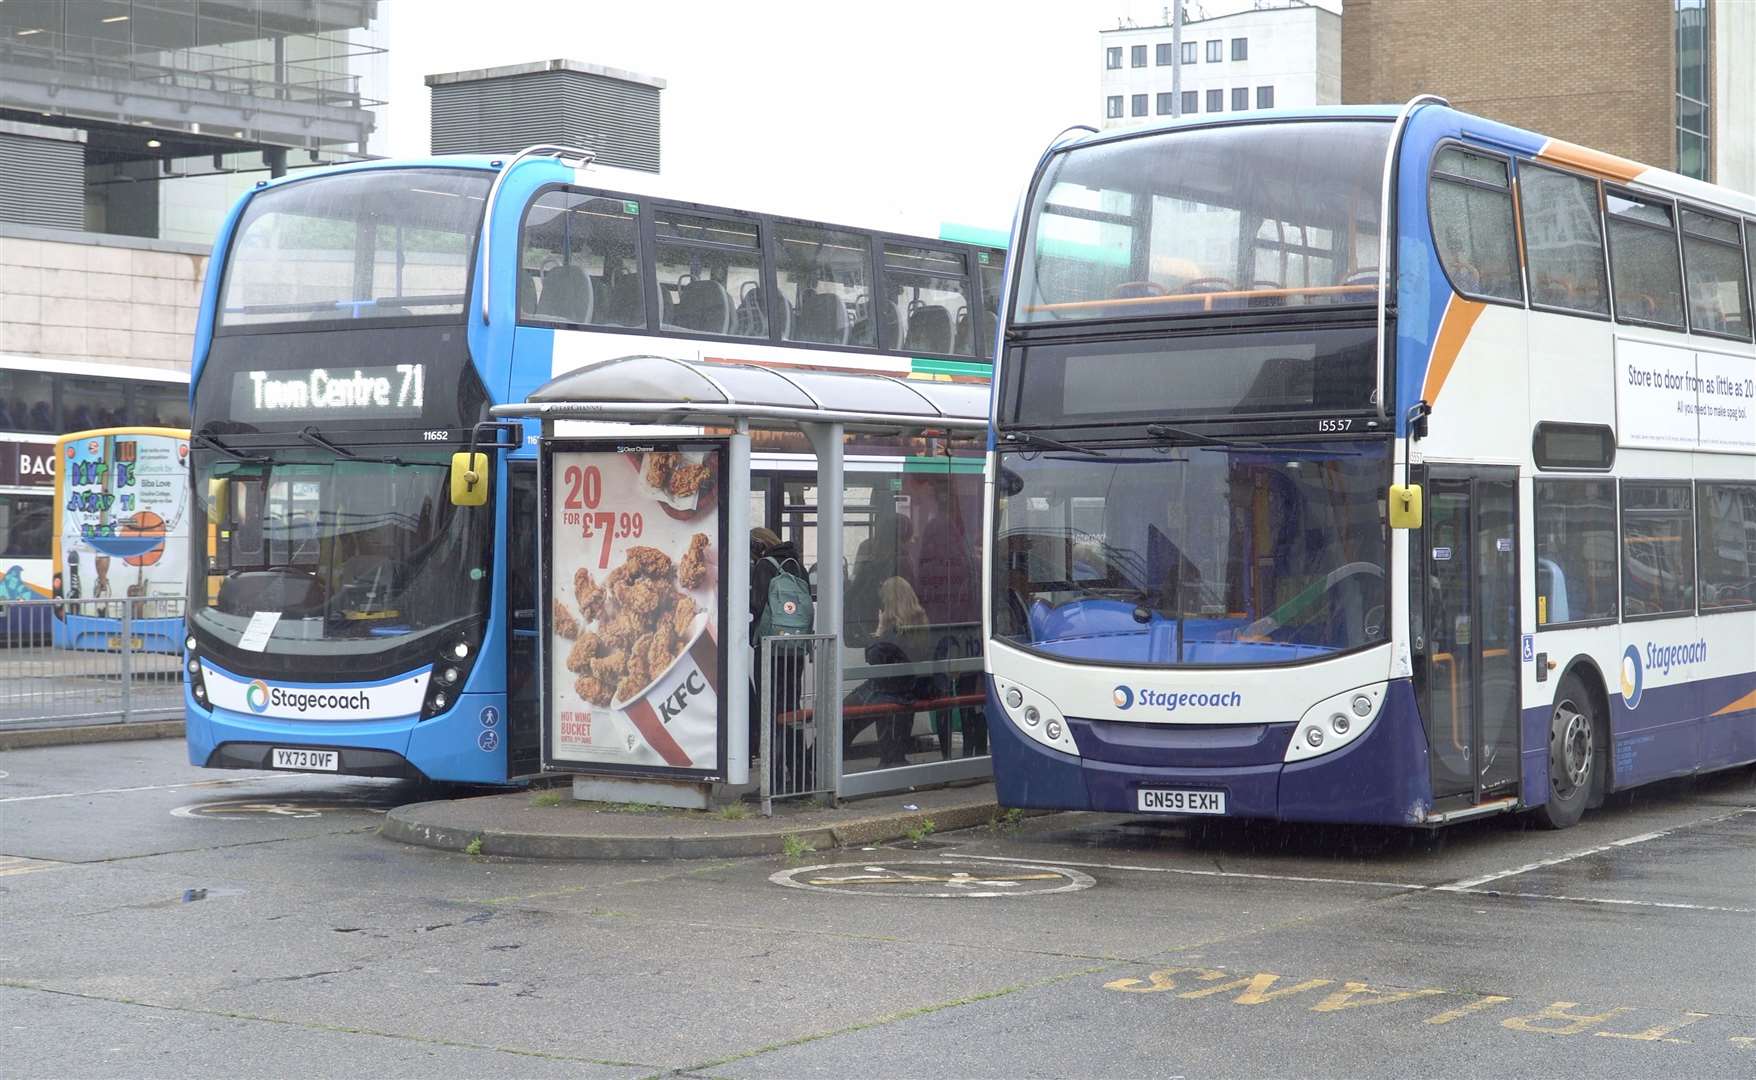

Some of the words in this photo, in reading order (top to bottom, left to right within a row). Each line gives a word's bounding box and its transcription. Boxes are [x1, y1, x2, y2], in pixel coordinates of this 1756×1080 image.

[250, 371, 308, 408] Town
[310, 368, 390, 407] Centre
[396, 364, 424, 407] 71
[1628, 364, 1651, 387] Store
[1653, 369, 1662, 388] to
[1664, 369, 1683, 390] door
[1686, 370, 1704, 393] from
[1706, 379, 1715, 394] as
[1716, 375, 1733, 396] little
[1735, 382, 1743, 397] as
[1744, 379, 1754, 398] 20
[1684, 404, 1693, 416] you
[1713, 406, 1726, 417] make
[1727, 408, 1738, 421] spag
[1318, 420, 1351, 431] 15557
[423, 431, 448, 441] 11652
[527, 435, 540, 445] 116
[1410, 451, 1422, 462] 5557
[564, 466, 601, 510] 20
[563, 513, 580, 525] FOR
[582, 512, 643, 569] £7.99
[1645, 638, 1707, 676] Stagecoach
[271, 688, 370, 712] Stagecoach
[658, 670, 707, 724] KFC
[1138, 688, 1241, 711] Stagecoach
[560, 711, 573, 721] HOT
[560, 723, 591, 736] BUCKET
[277, 751, 306, 767] YX73
[309, 752, 333, 768] OVF
[1144, 791, 1184, 809] GN59
[1188, 793, 1219, 810] EXH
